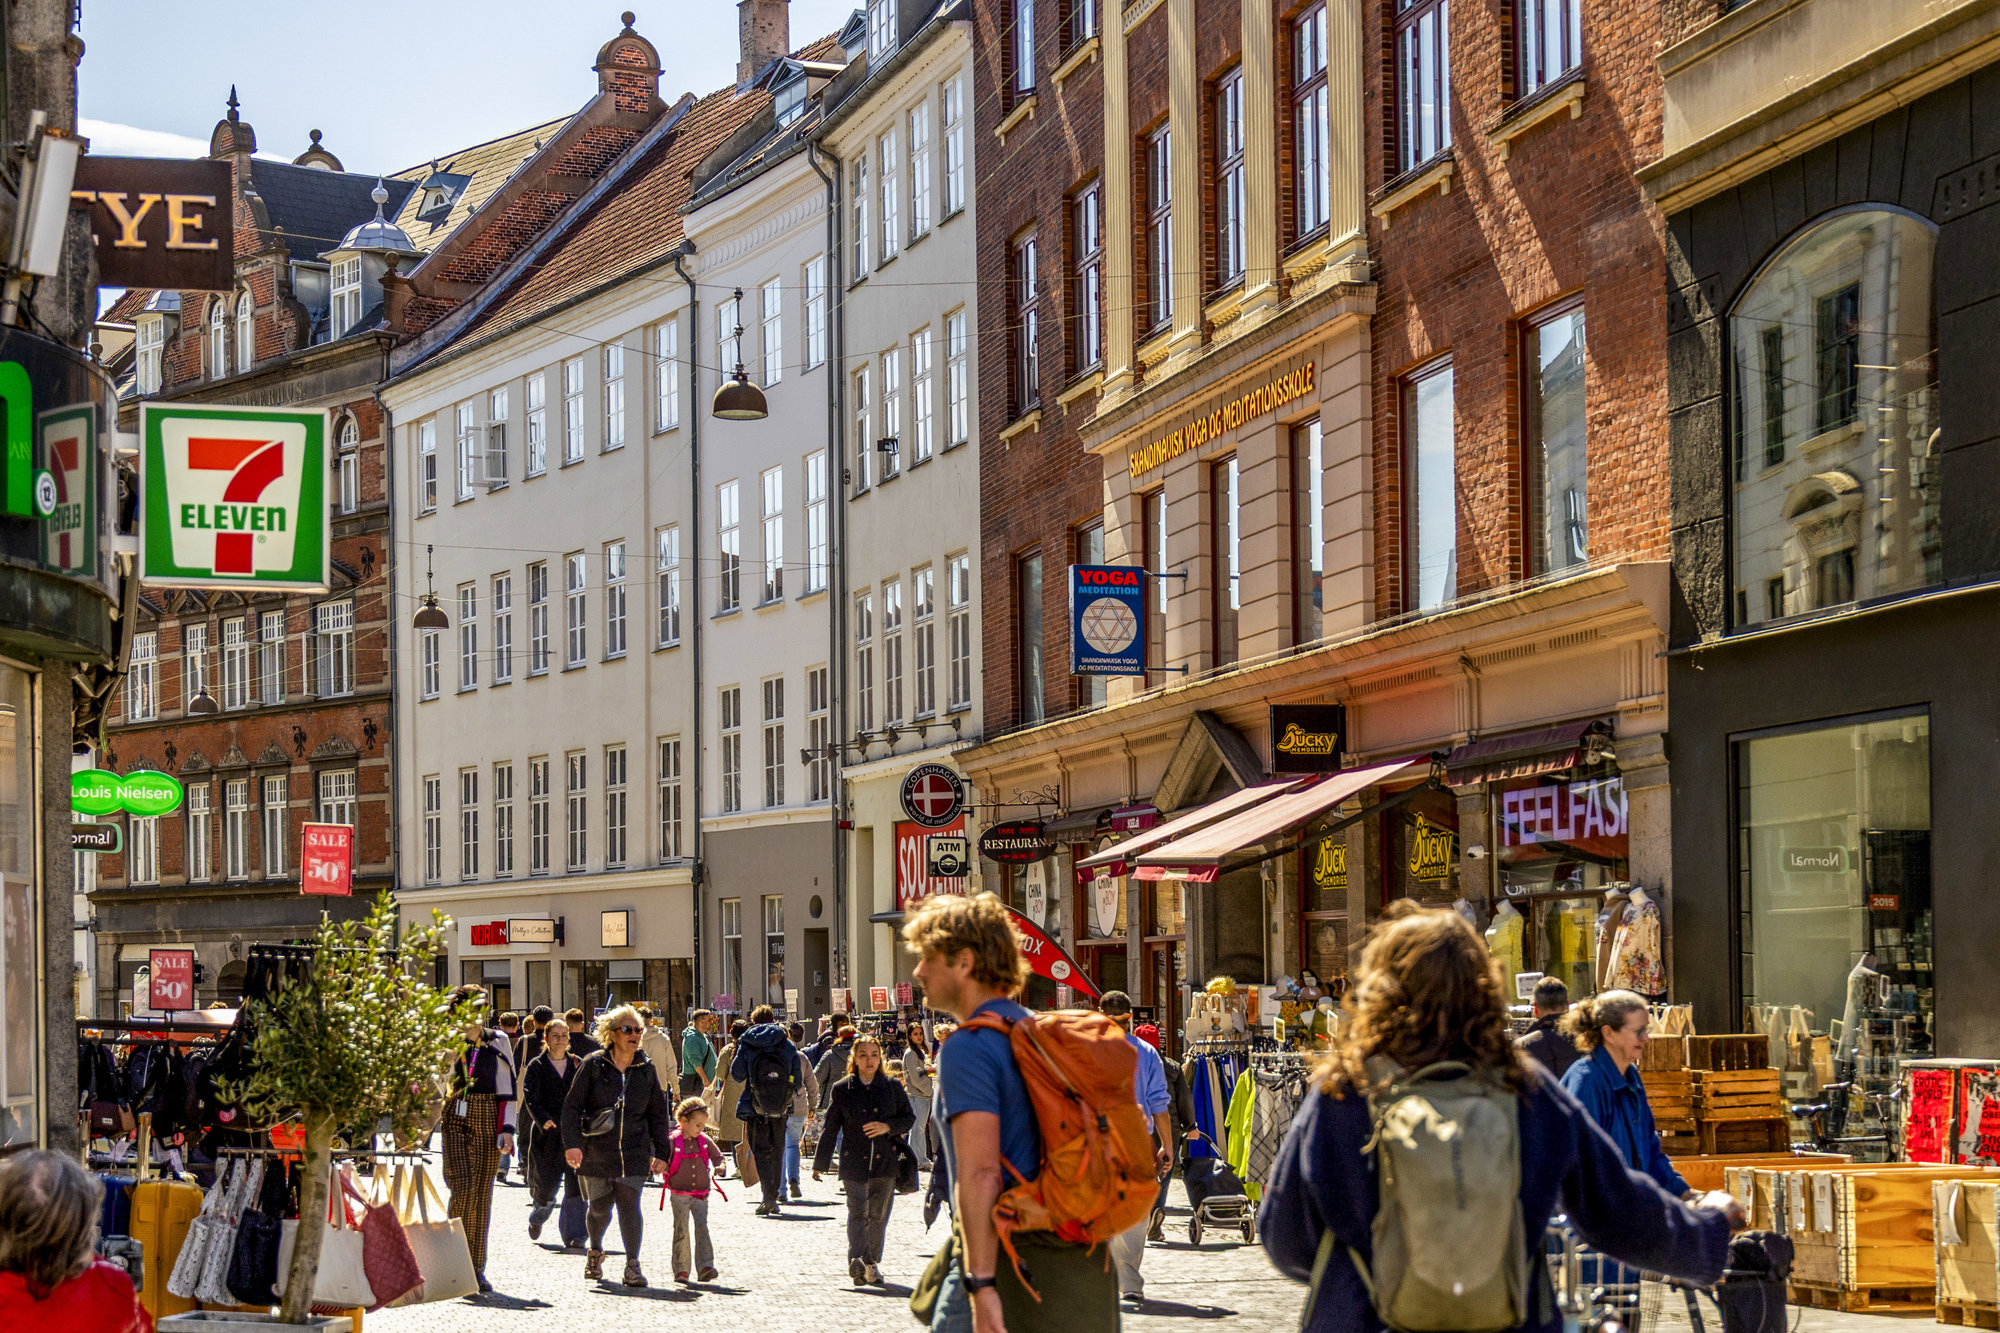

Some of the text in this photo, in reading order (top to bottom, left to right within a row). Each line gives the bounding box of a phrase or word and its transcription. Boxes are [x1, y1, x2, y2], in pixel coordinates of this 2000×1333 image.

[71, 190, 218, 249] YE
[1184, 418, 1208, 450] YOGA
[1209, 409, 1223, 439] OG
[1223, 362, 1316, 432] MEDITATIONSSKOLE
[1078, 570, 1139, 586] YOGA
[1078, 585, 1139, 595] MEDITATION
[907, 766, 960, 789] COPENHAGEN
[71, 785, 173, 800] Louis Nielsen
[308, 833, 348, 847] SALE
[984, 838, 1051, 850] RESTAURAN
[936, 843, 960, 852] ATM
[1873, 898, 1895, 907] 2015
[1019, 936, 1044, 956] OX
[155, 957, 188, 968] SALE
[1915, 1089, 1943, 1100] WORLD
